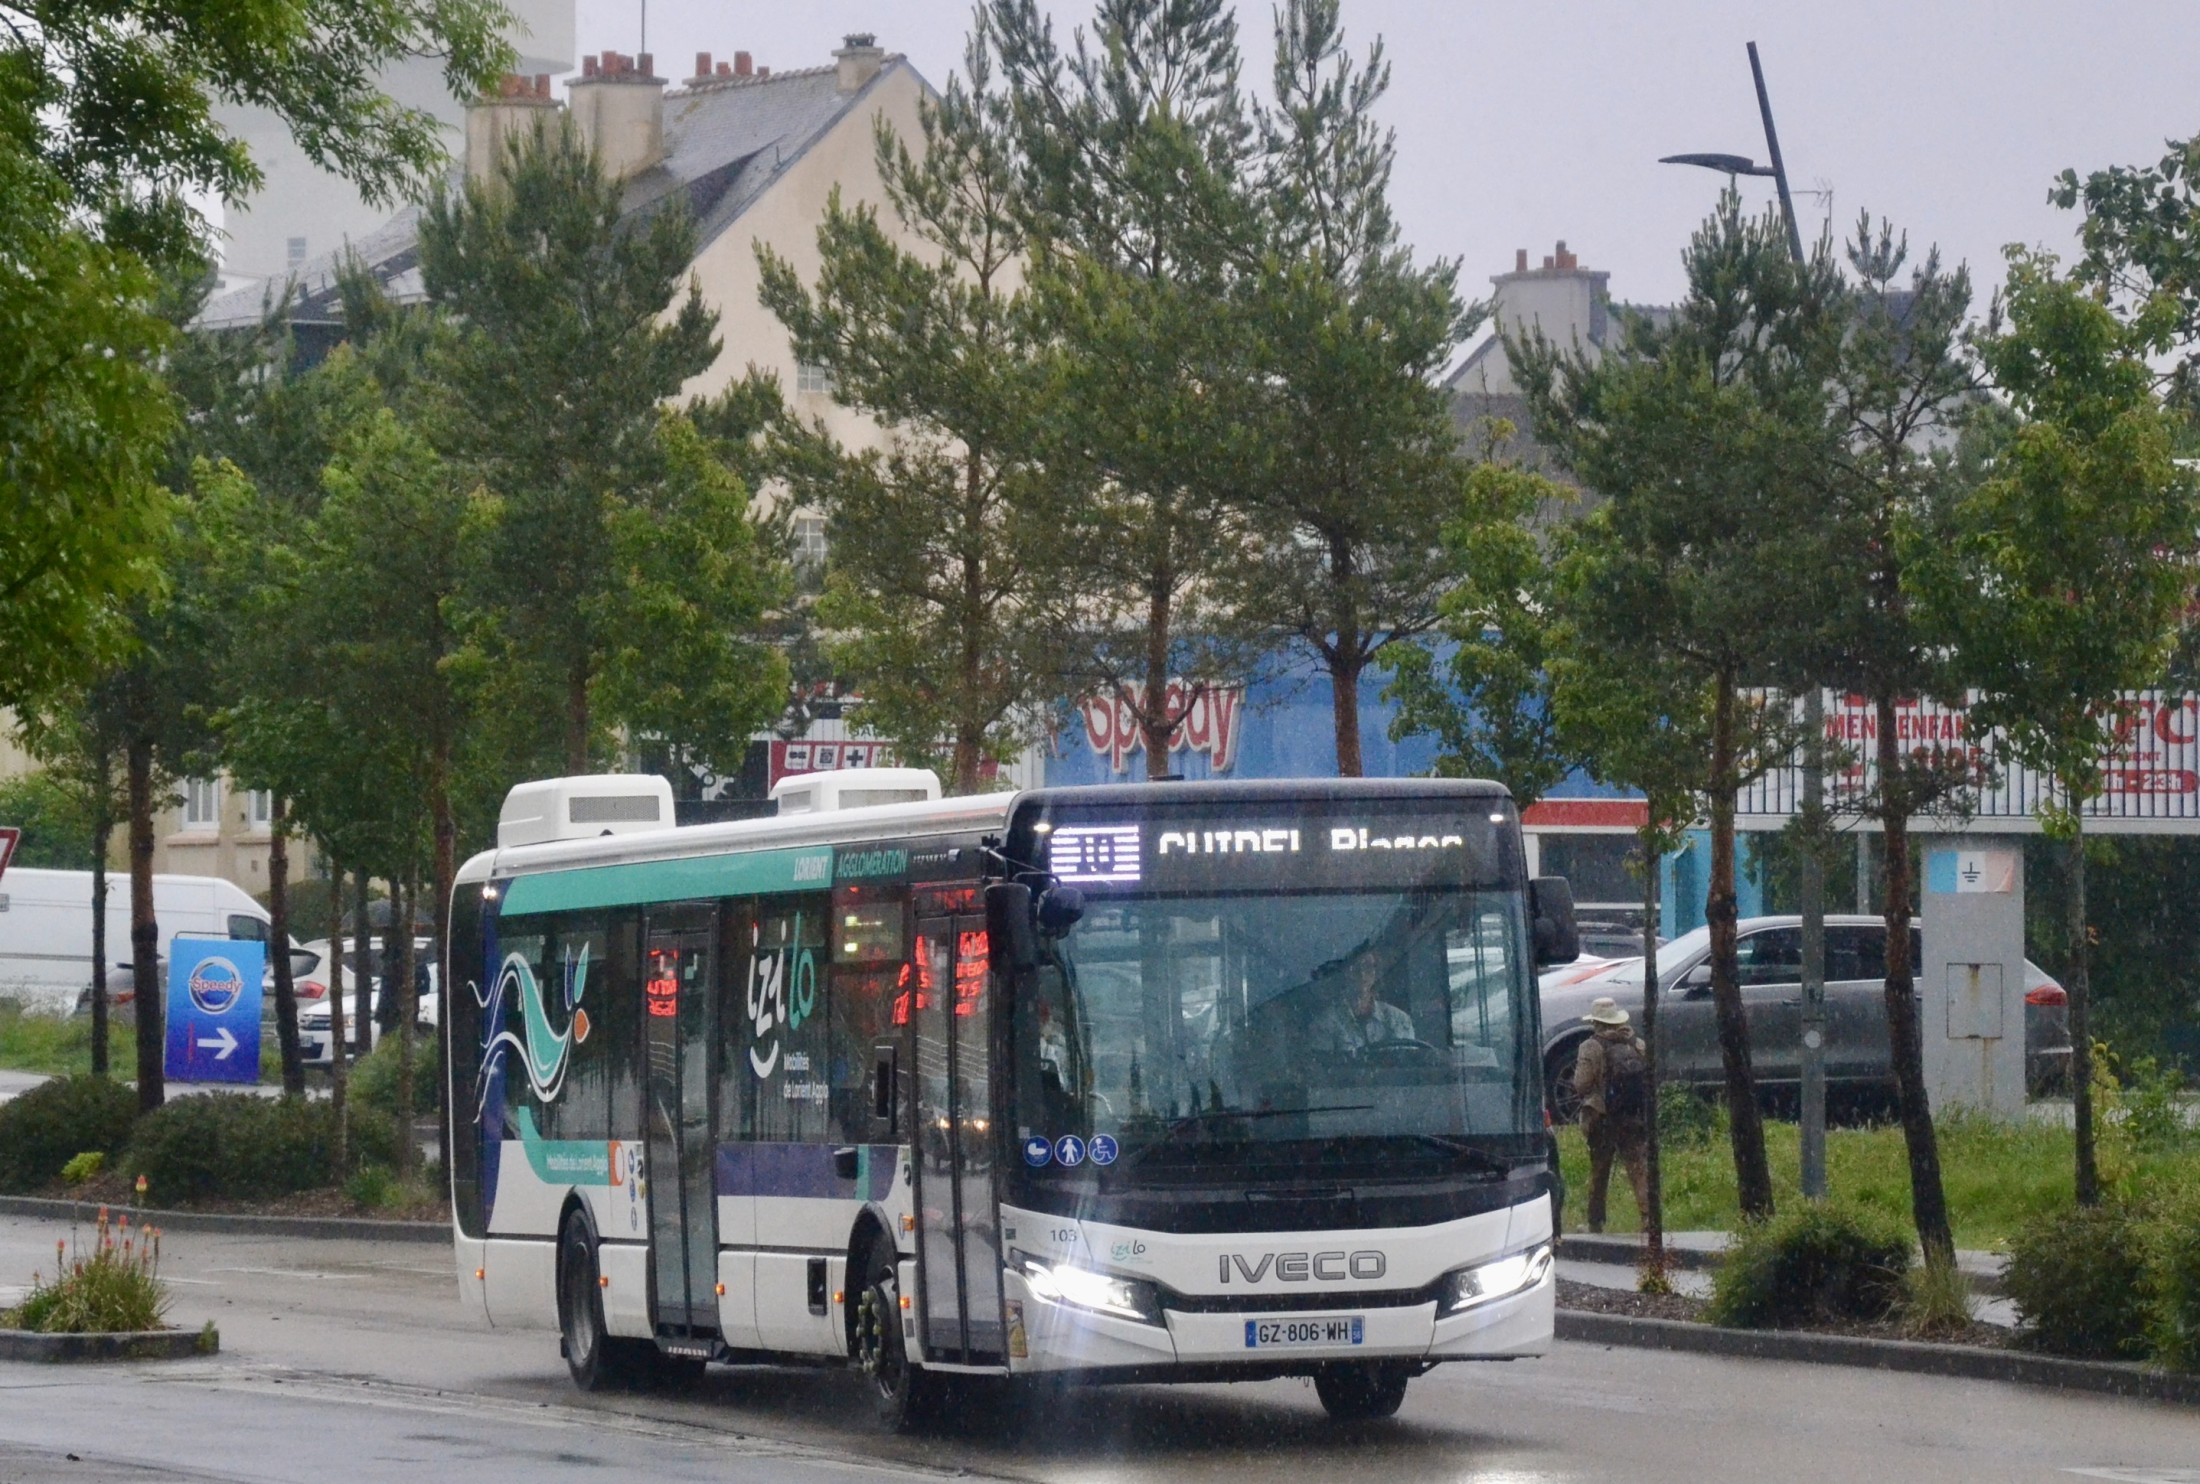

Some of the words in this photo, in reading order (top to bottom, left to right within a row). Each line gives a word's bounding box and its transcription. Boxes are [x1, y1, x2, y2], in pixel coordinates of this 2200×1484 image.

[190, 977, 243, 993] Speedy
[1219, 1250, 1386, 1284] IVECO
[1258, 1321, 1349, 1343] GZ-806-WH
